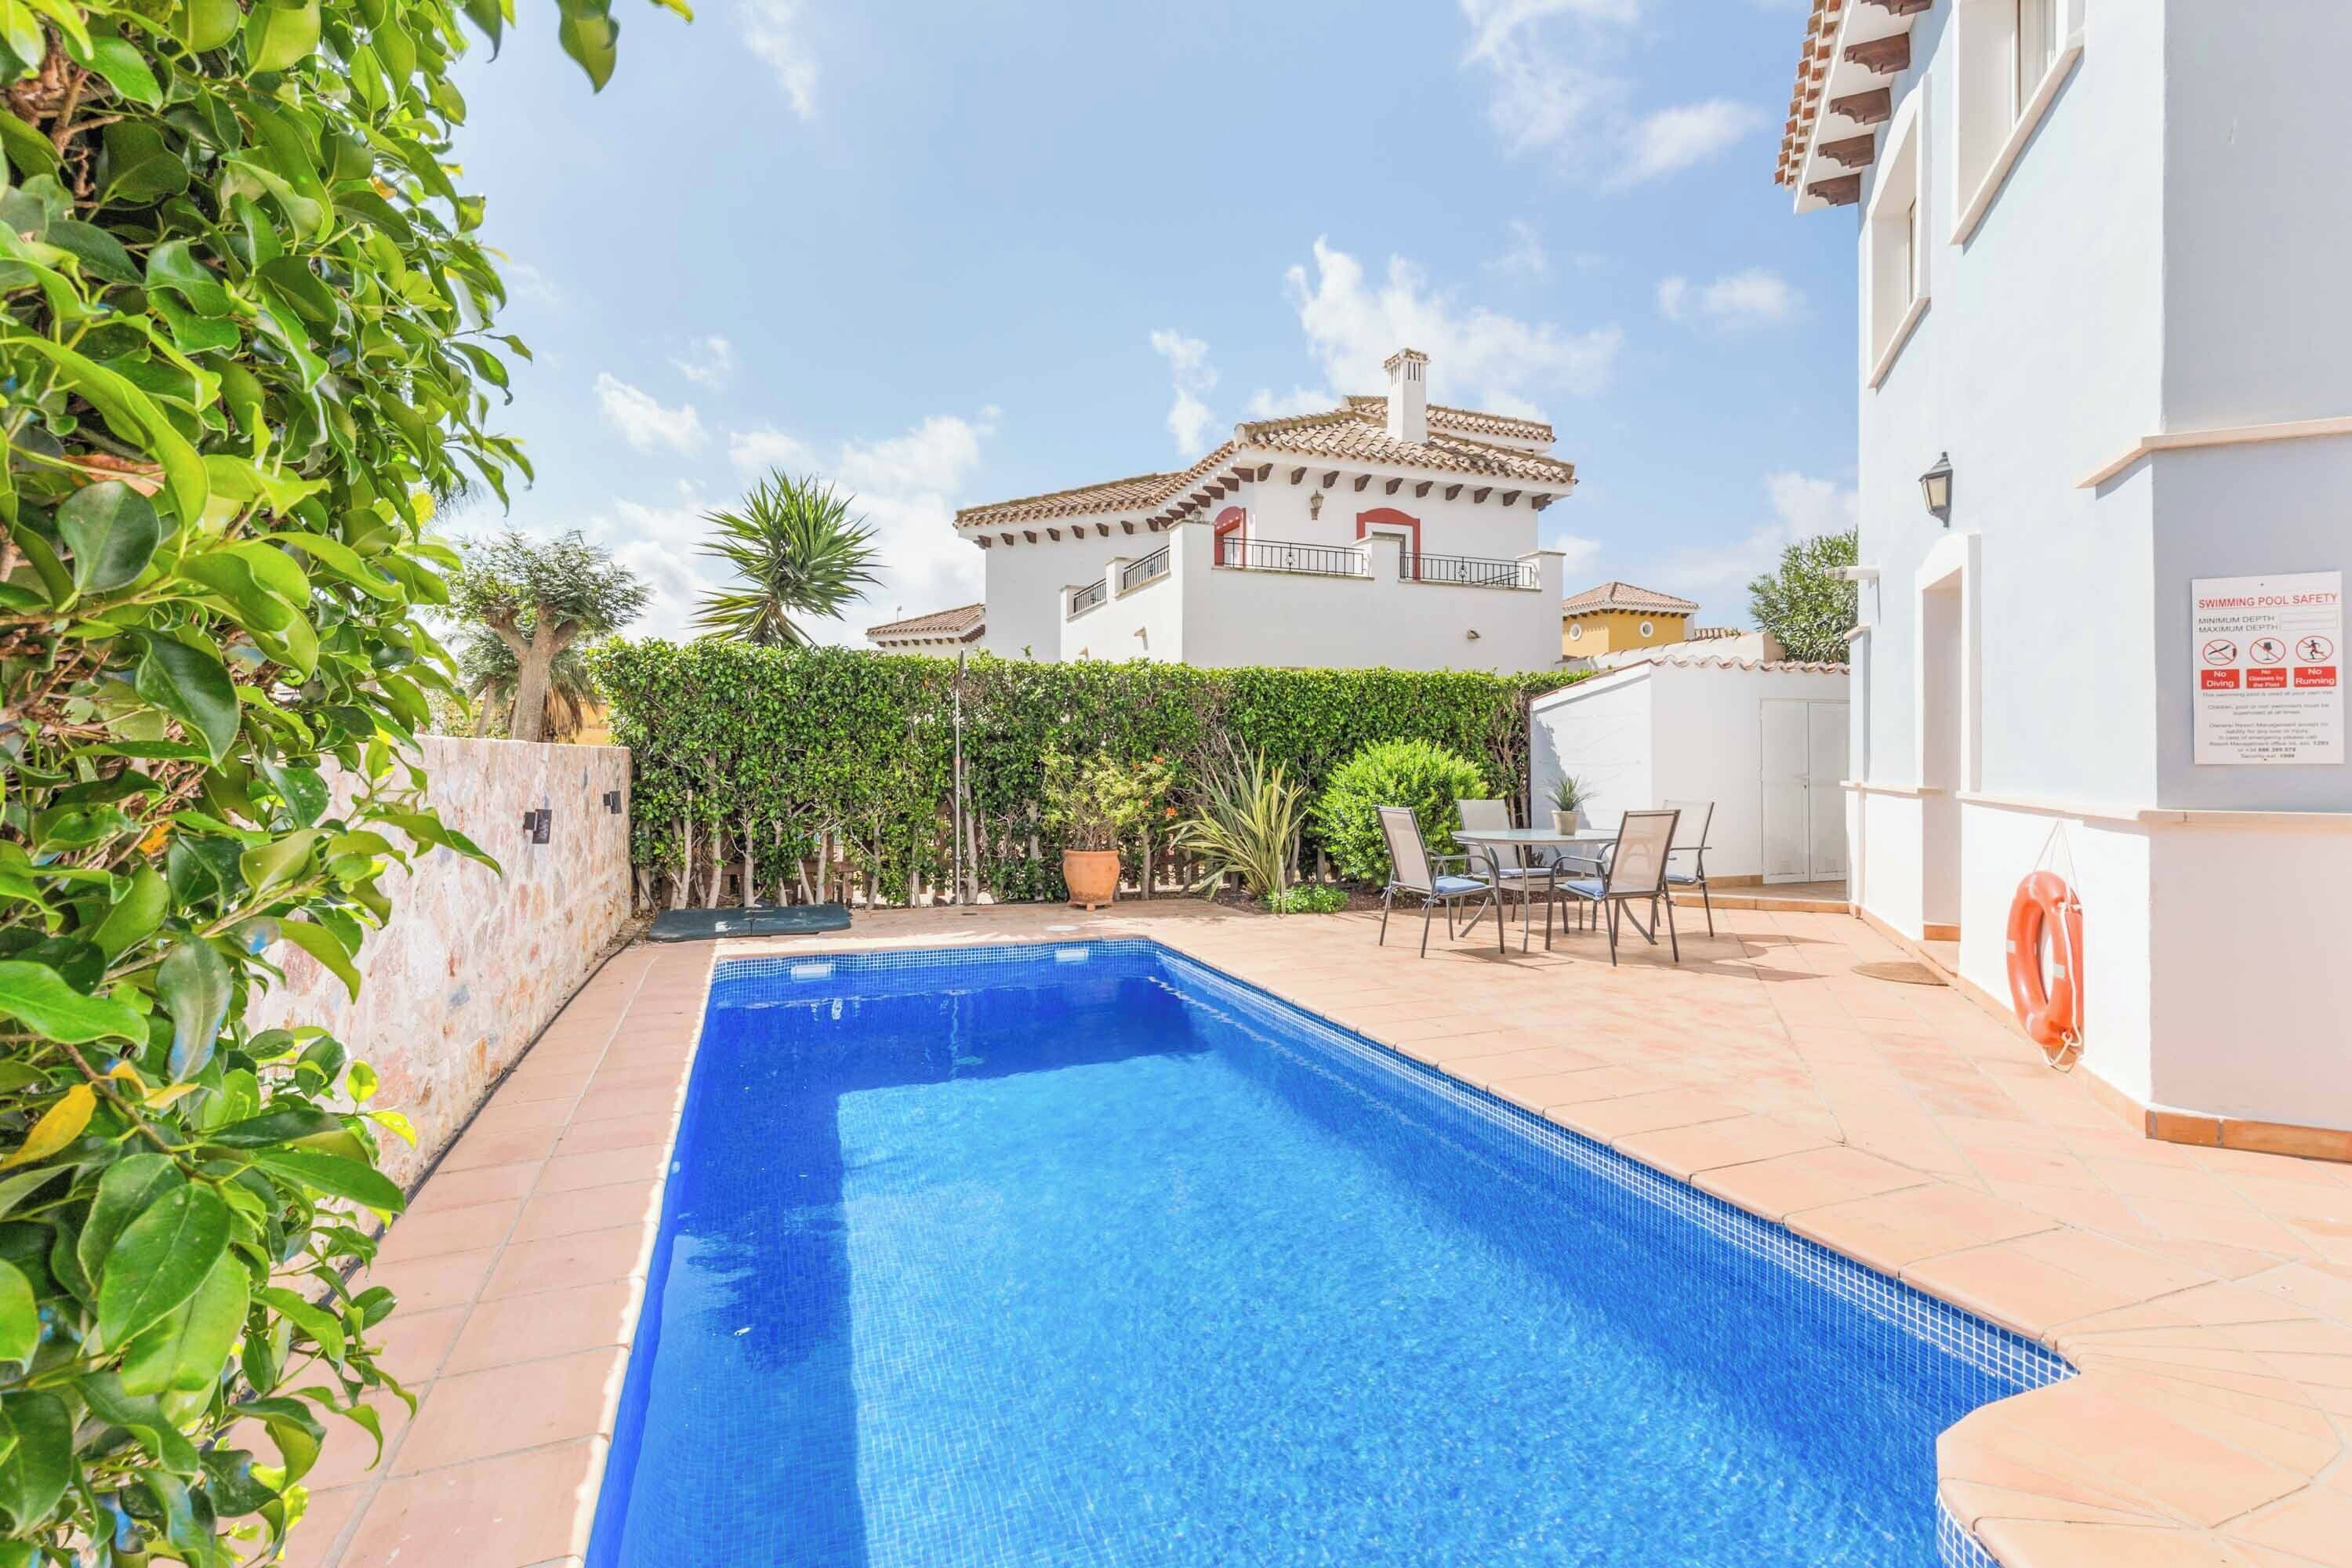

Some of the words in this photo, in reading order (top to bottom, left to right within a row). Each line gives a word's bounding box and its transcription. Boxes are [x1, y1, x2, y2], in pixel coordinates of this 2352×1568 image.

[2198, 597, 2255, 608] SWIMMING
[2258, 595, 2288, 606] POOL
[2292, 593, 2338, 604] SAFETY
[2207, 678, 2234, 688] Diving
[2296, 677, 2335, 685] Running
